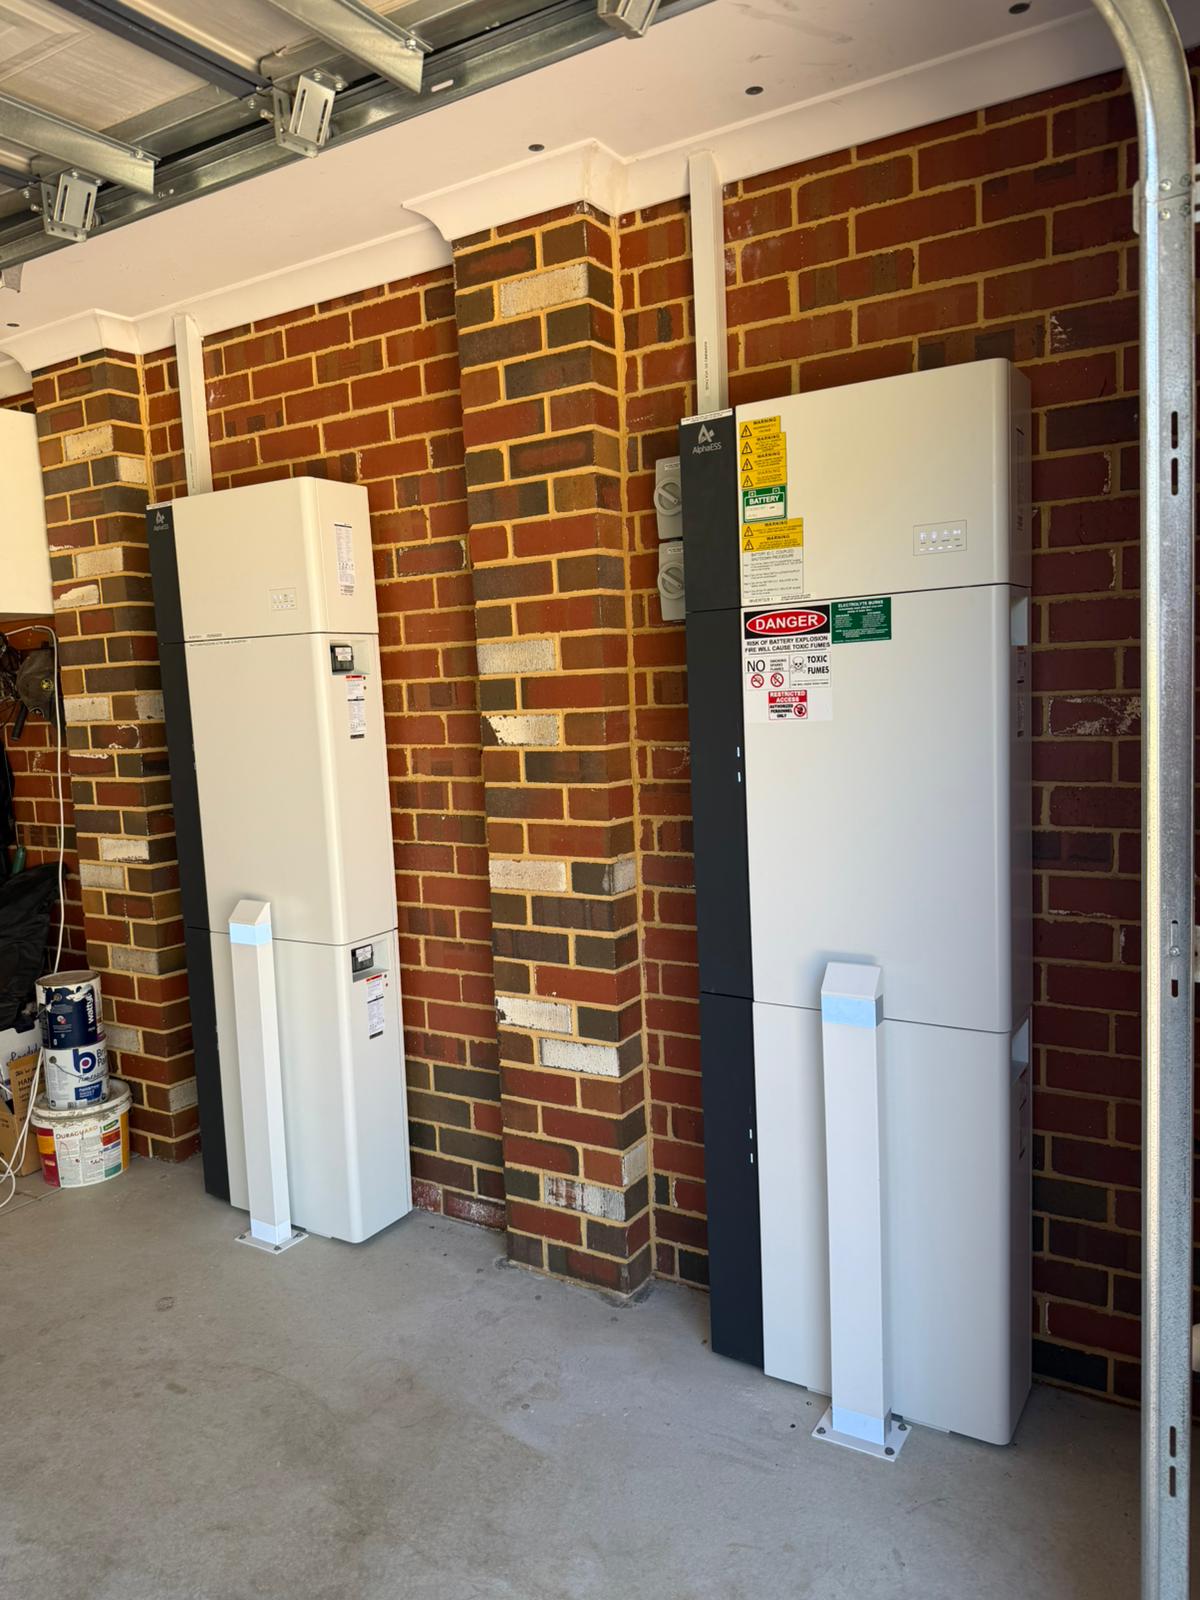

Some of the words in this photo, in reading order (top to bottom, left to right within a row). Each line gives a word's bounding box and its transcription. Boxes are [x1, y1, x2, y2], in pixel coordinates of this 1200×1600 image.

[692, 442, 722, 454] AlphaESS
[749, 494, 780, 505] BATTERY
[755, 614, 819, 631] DANGER
[769, 637, 794, 645] BATTERY
[807, 655, 828, 663] TOXIC
[747, 659, 766, 673] NO
[807, 666, 830, 674] FUMES
